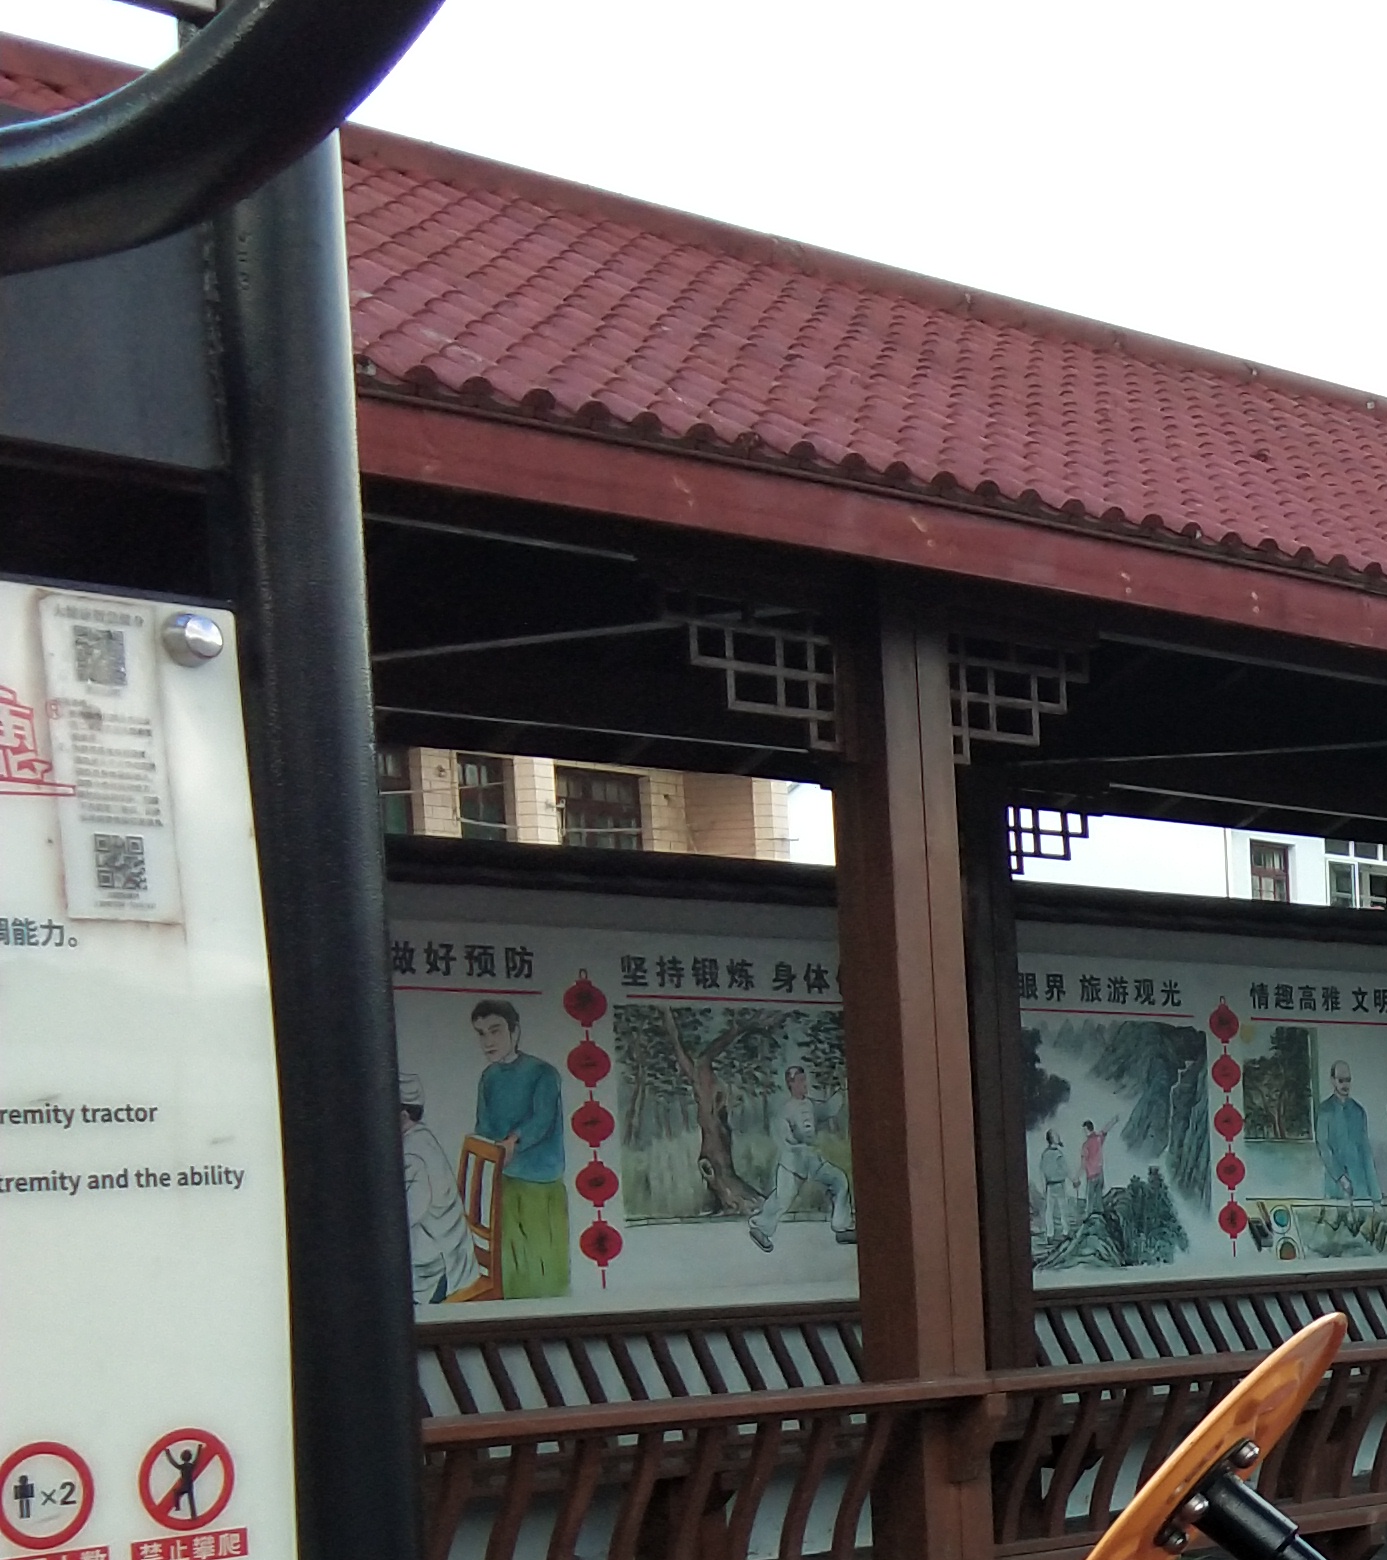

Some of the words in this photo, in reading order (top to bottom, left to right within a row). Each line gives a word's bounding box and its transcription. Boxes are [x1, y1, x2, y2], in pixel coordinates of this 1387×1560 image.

[1079, 975, 1184, 1008] 旅游观光
[1249, 981, 1342, 1012] 情趣高雅
[81, 1104, 158, 1123] tractor
[87, 1168, 129, 1190] and
[134, 1167, 171, 1188] the
[177, 1165, 245, 1190] ability
